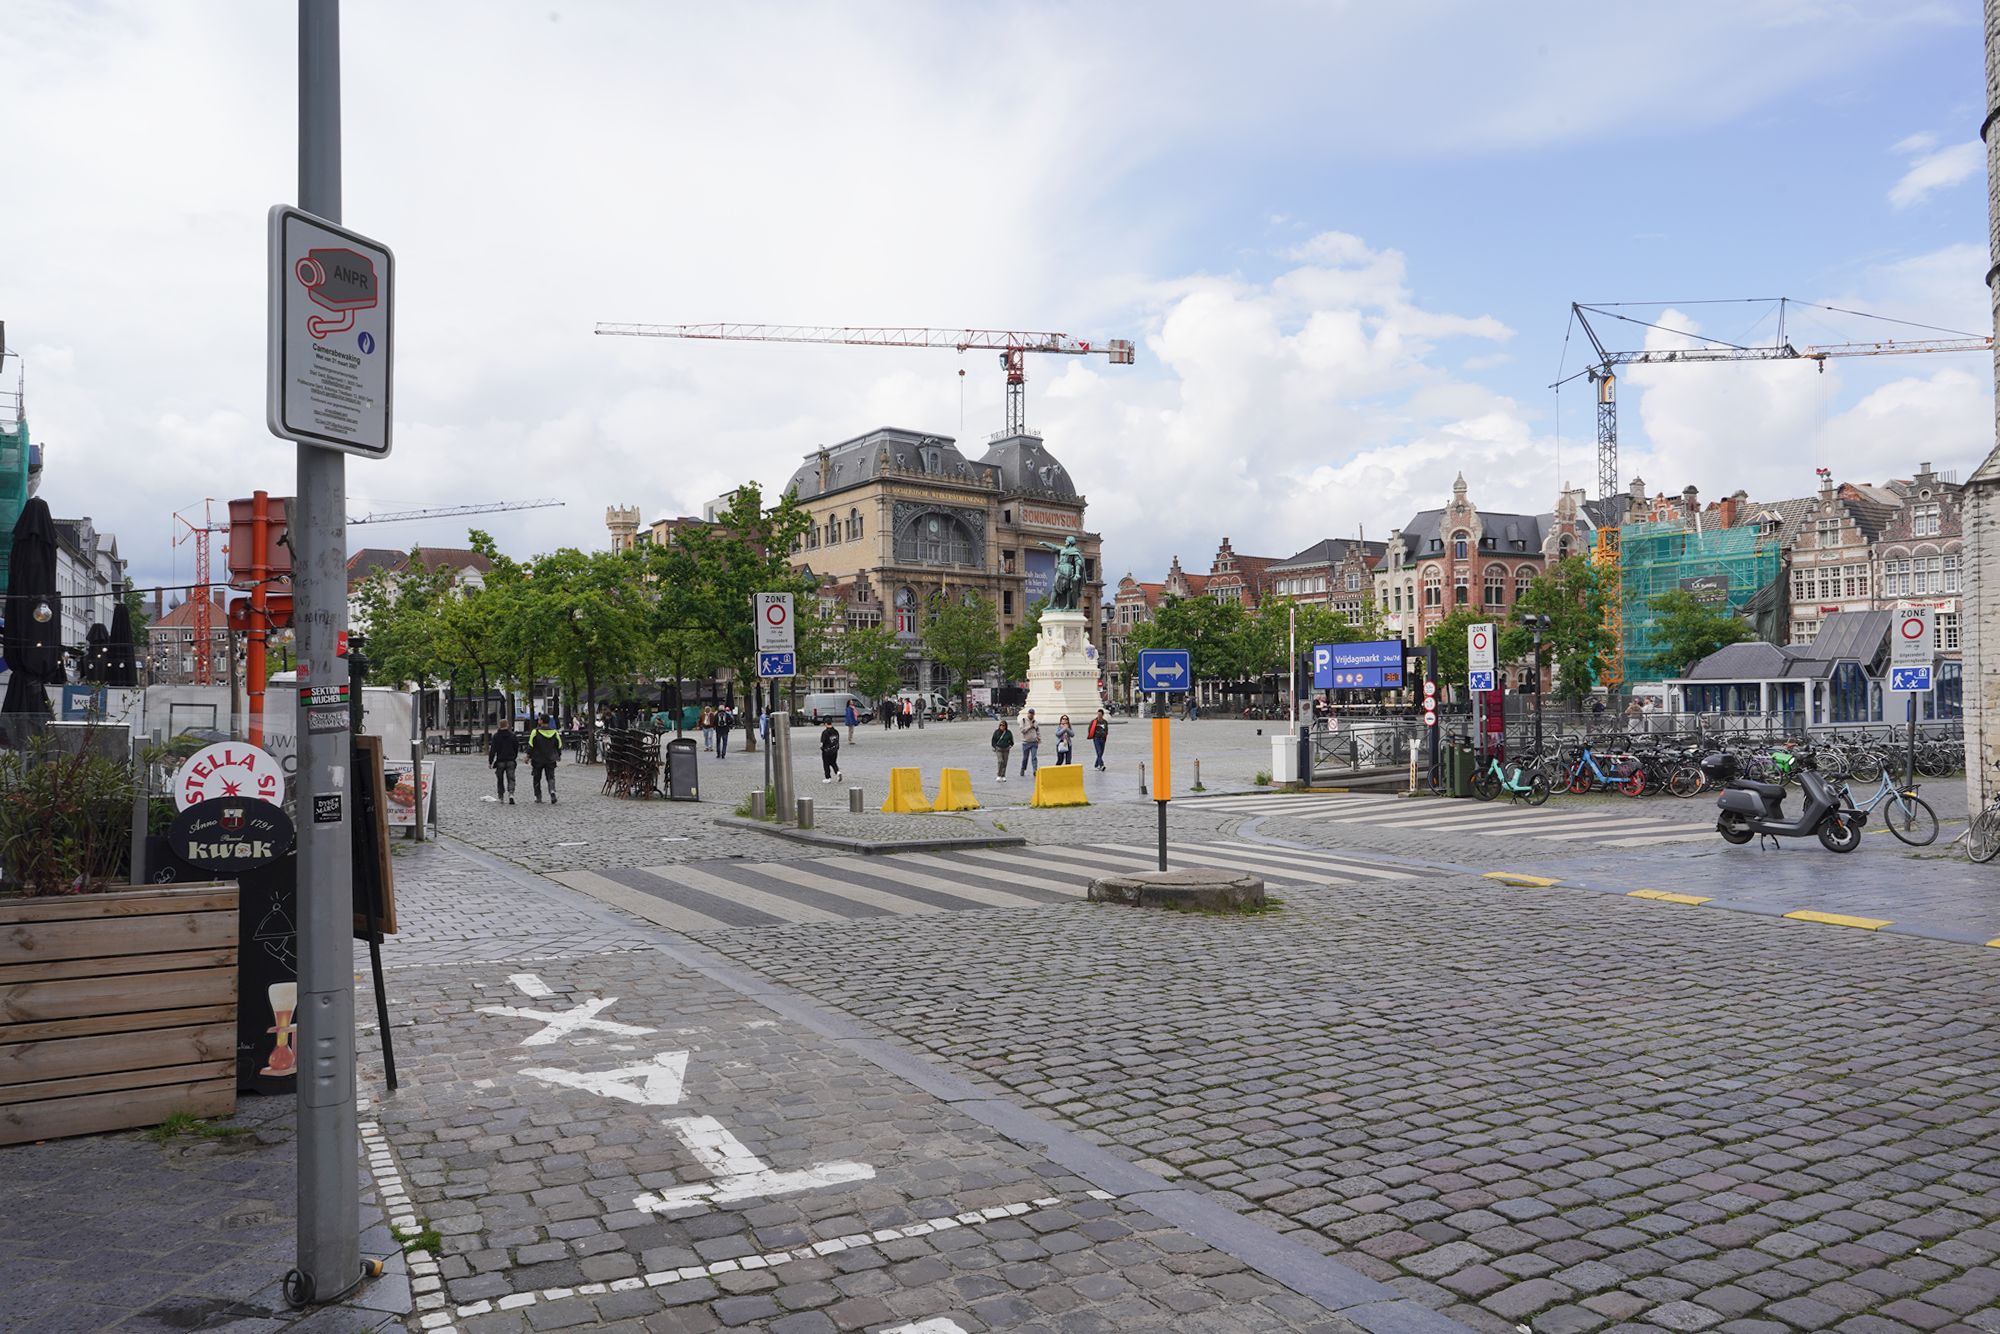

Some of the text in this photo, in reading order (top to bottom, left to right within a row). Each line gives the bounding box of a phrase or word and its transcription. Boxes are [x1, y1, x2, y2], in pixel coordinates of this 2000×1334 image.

[334, 264, 369, 290] ANPR
[313, 343, 360, 365] Camerabewaking
[765, 595, 787, 603] ZONE
[1901, 609, 1926, 617] ZONE
[1335, 653, 1380, 666] Vrijdagmarkt
[311, 686, 341, 696] SEKTION
[185, 749, 257, 805] STELLA
[189, 818, 274, 834] Anno 1791
[474, 973, 877, 1214] TAXI
